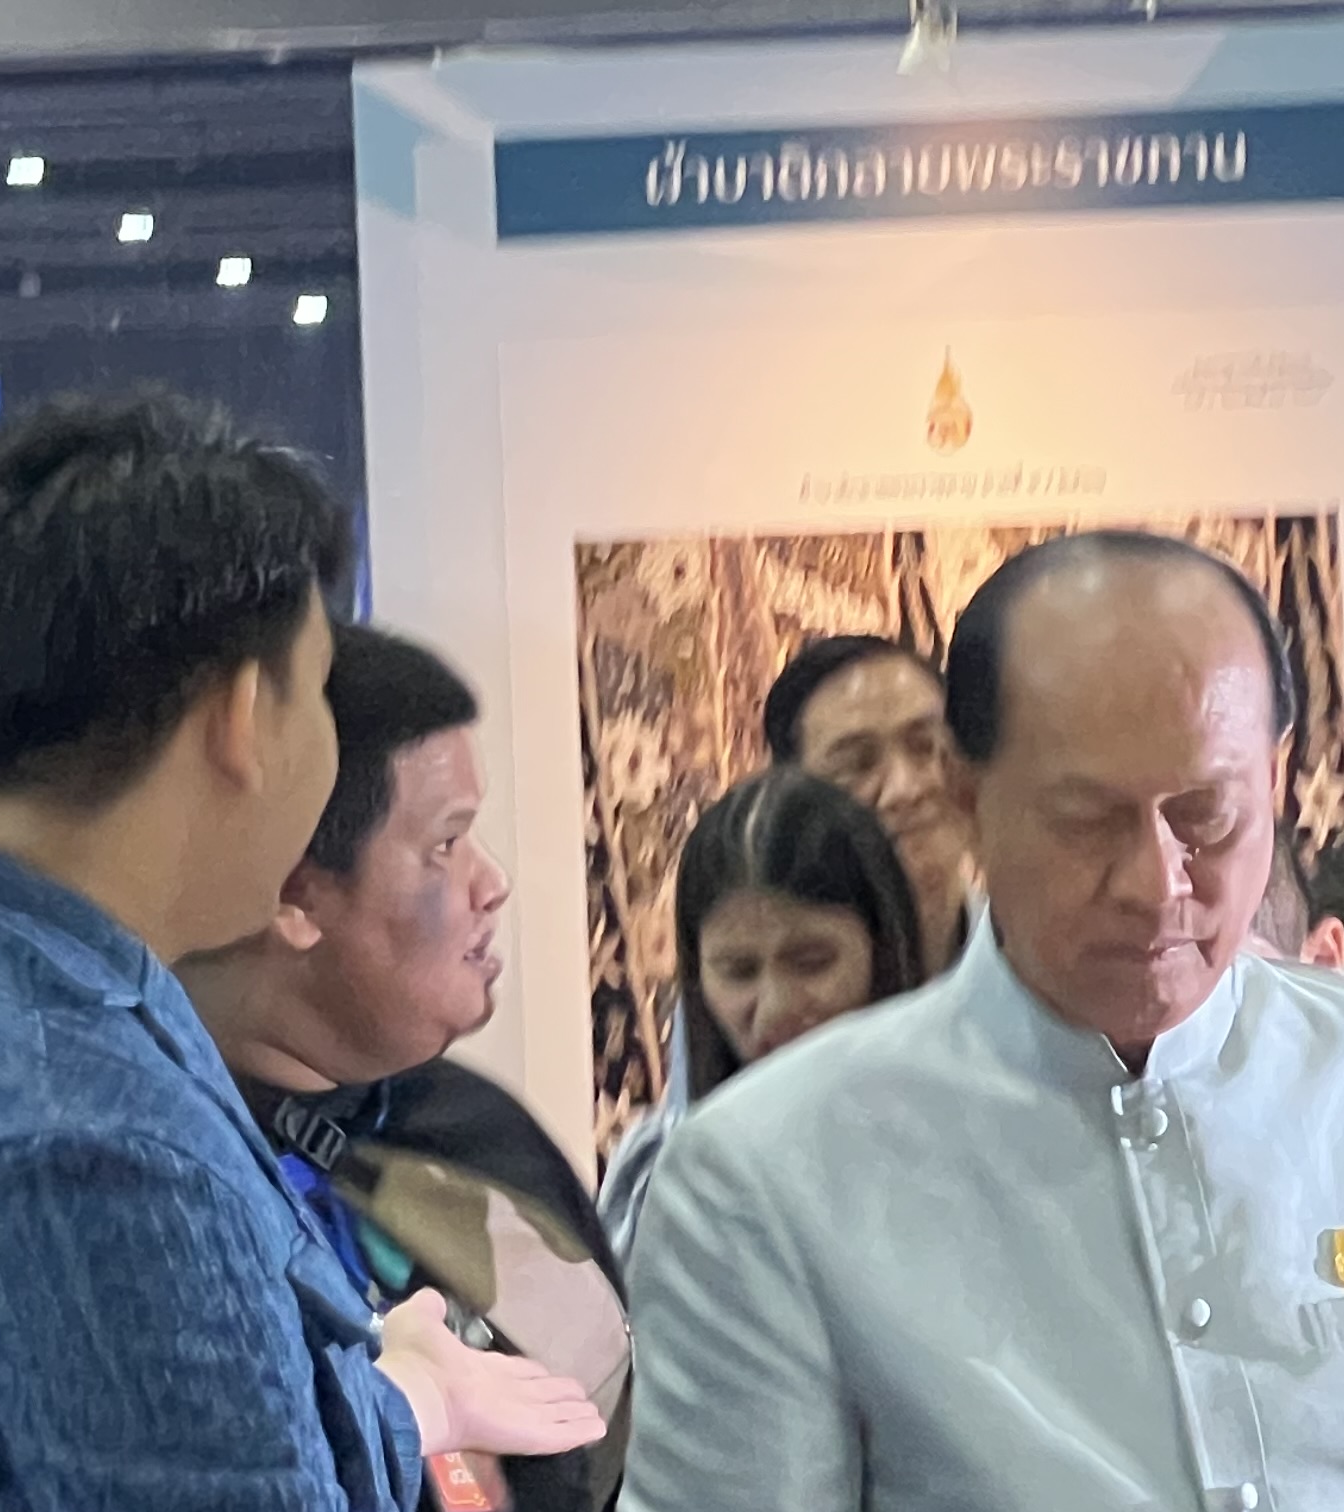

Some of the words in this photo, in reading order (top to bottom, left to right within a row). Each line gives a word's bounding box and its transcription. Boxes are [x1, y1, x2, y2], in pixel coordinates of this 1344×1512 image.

[646, 130, 1245, 206] ผ้าบาติกลายพระราชทาน
